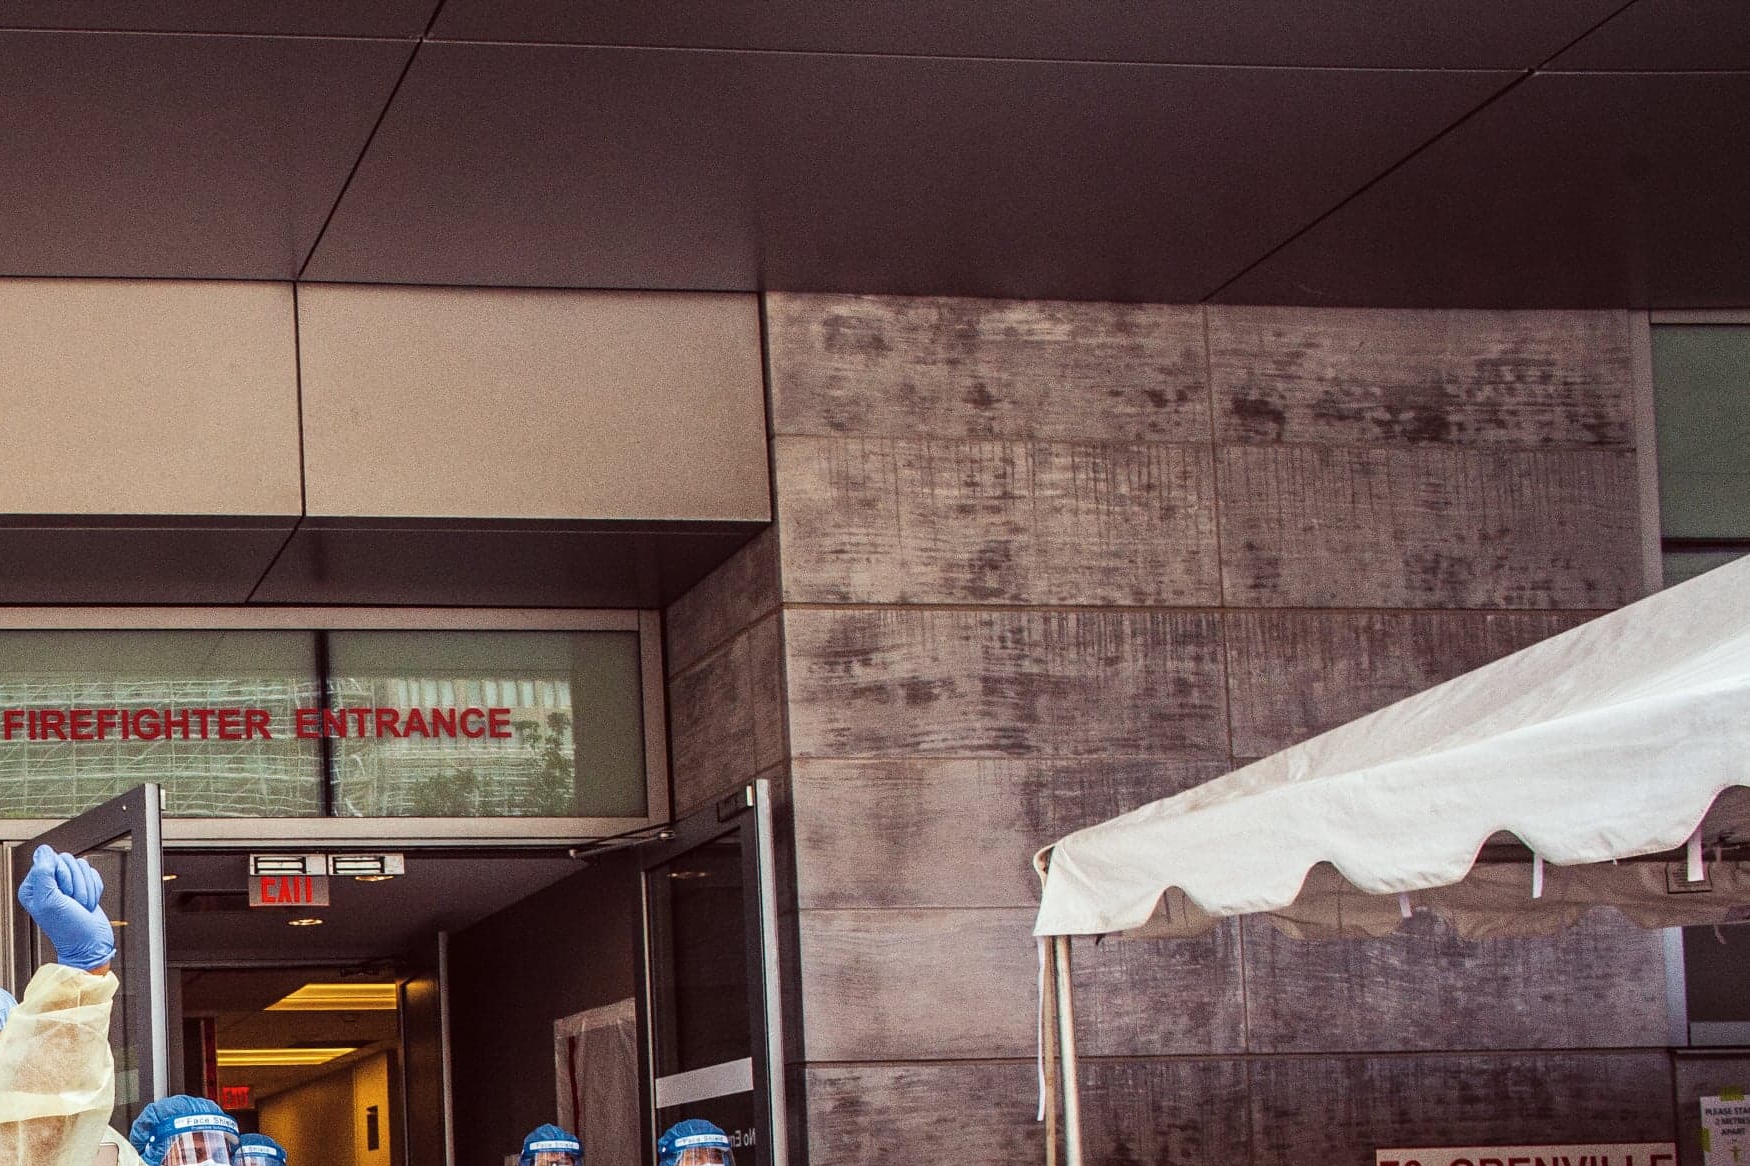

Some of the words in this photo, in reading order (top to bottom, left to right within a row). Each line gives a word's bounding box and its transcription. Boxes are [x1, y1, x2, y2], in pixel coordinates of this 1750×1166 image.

[3, 709, 273, 741] FIREFIGHTER
[295, 707, 513, 739] ENTRANCE
[186, 1117, 210, 1126] Face
